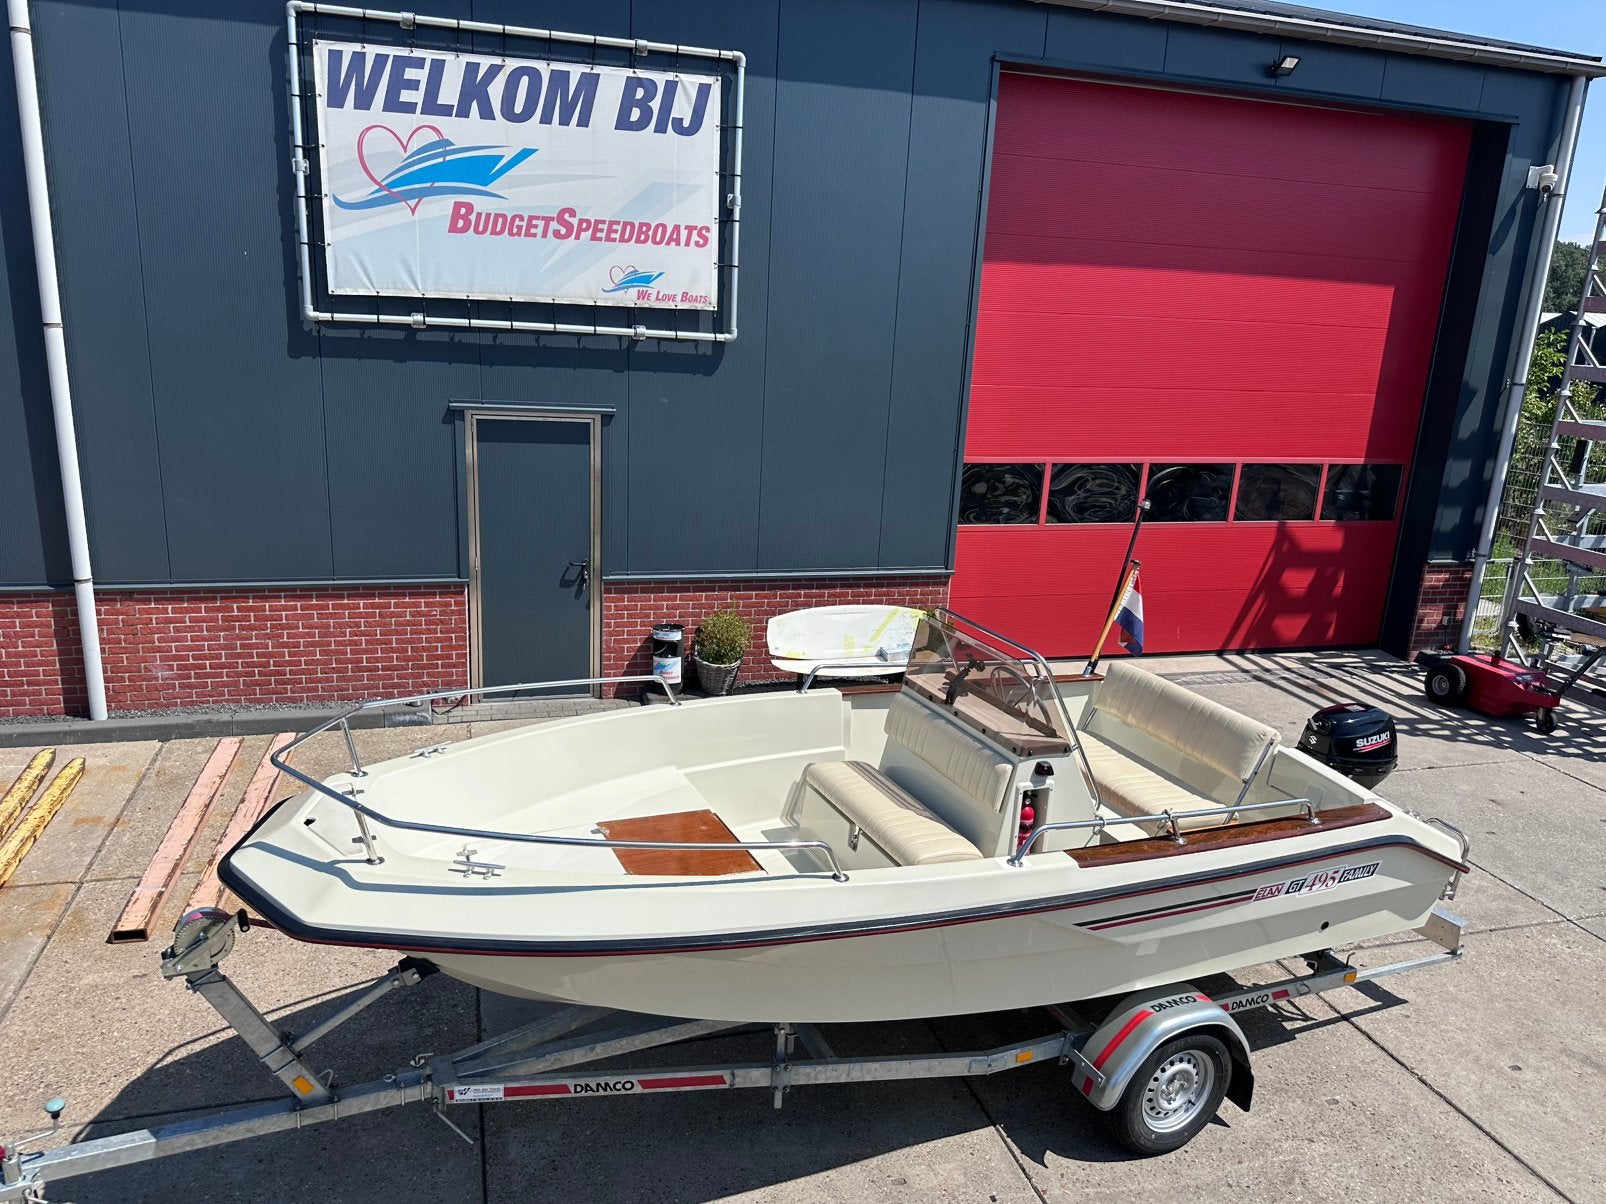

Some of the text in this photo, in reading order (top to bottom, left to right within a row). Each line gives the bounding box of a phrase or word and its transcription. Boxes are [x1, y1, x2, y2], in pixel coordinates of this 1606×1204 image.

[326, 49, 712, 137] WELKOM BIJ
[448, 200, 711, 249] BUDGETSPEEDBOATS
[637, 289, 708, 304] WE LOVE BOATS
[1355, 730, 1390, 748] SUZUKI
[1255, 885, 1284, 899] ELAN
[1304, 869, 1340, 891] 495
[1341, 863, 1378, 881] FAMILY
[1150, 995, 1197, 1013] DAMCO
[1231, 993, 1270, 1011] DAMCO
[573, 1080, 635, 1095] DAMCO
